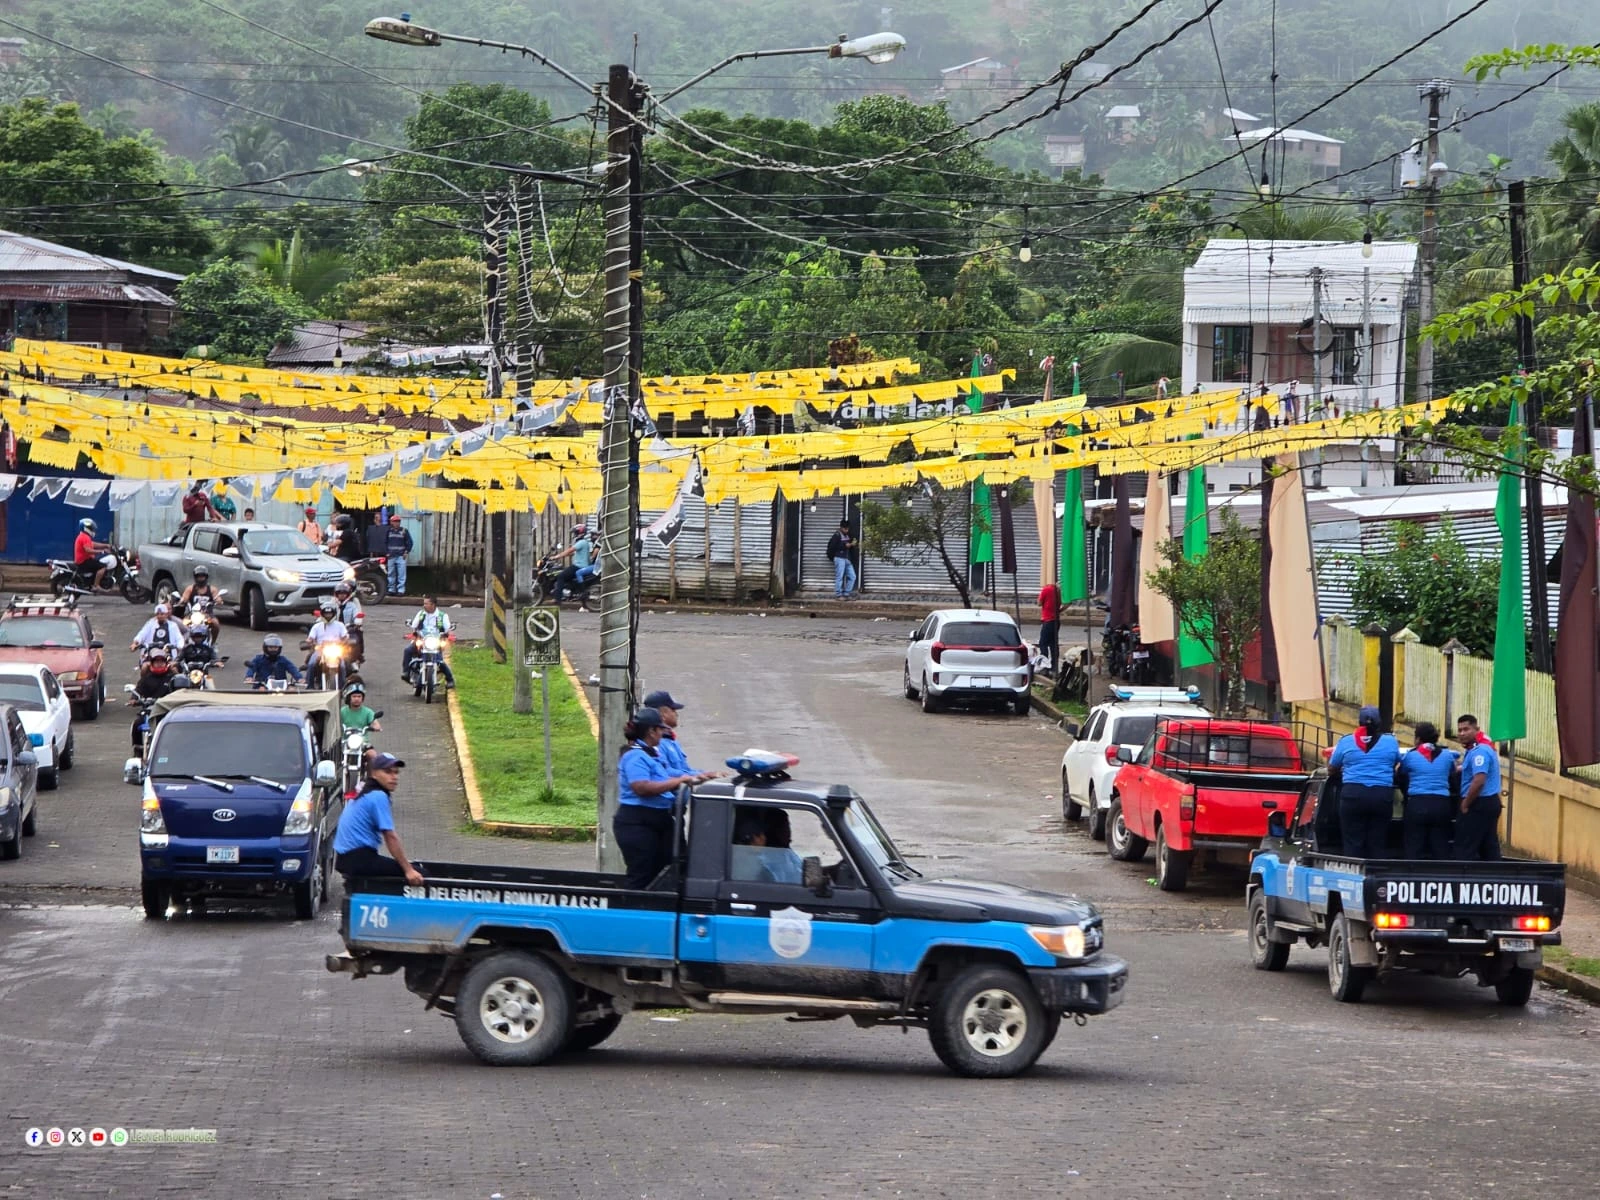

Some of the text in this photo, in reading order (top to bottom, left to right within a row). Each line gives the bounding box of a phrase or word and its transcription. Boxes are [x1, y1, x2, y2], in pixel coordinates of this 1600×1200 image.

[403, 885, 426, 899] SUB
[504, 890, 557, 907] BONANZA
[1386, 882, 1453, 904] POLICIA
[1459, 883, 1543, 906] NACIONAL
[359, 904, 389, 929] 746
